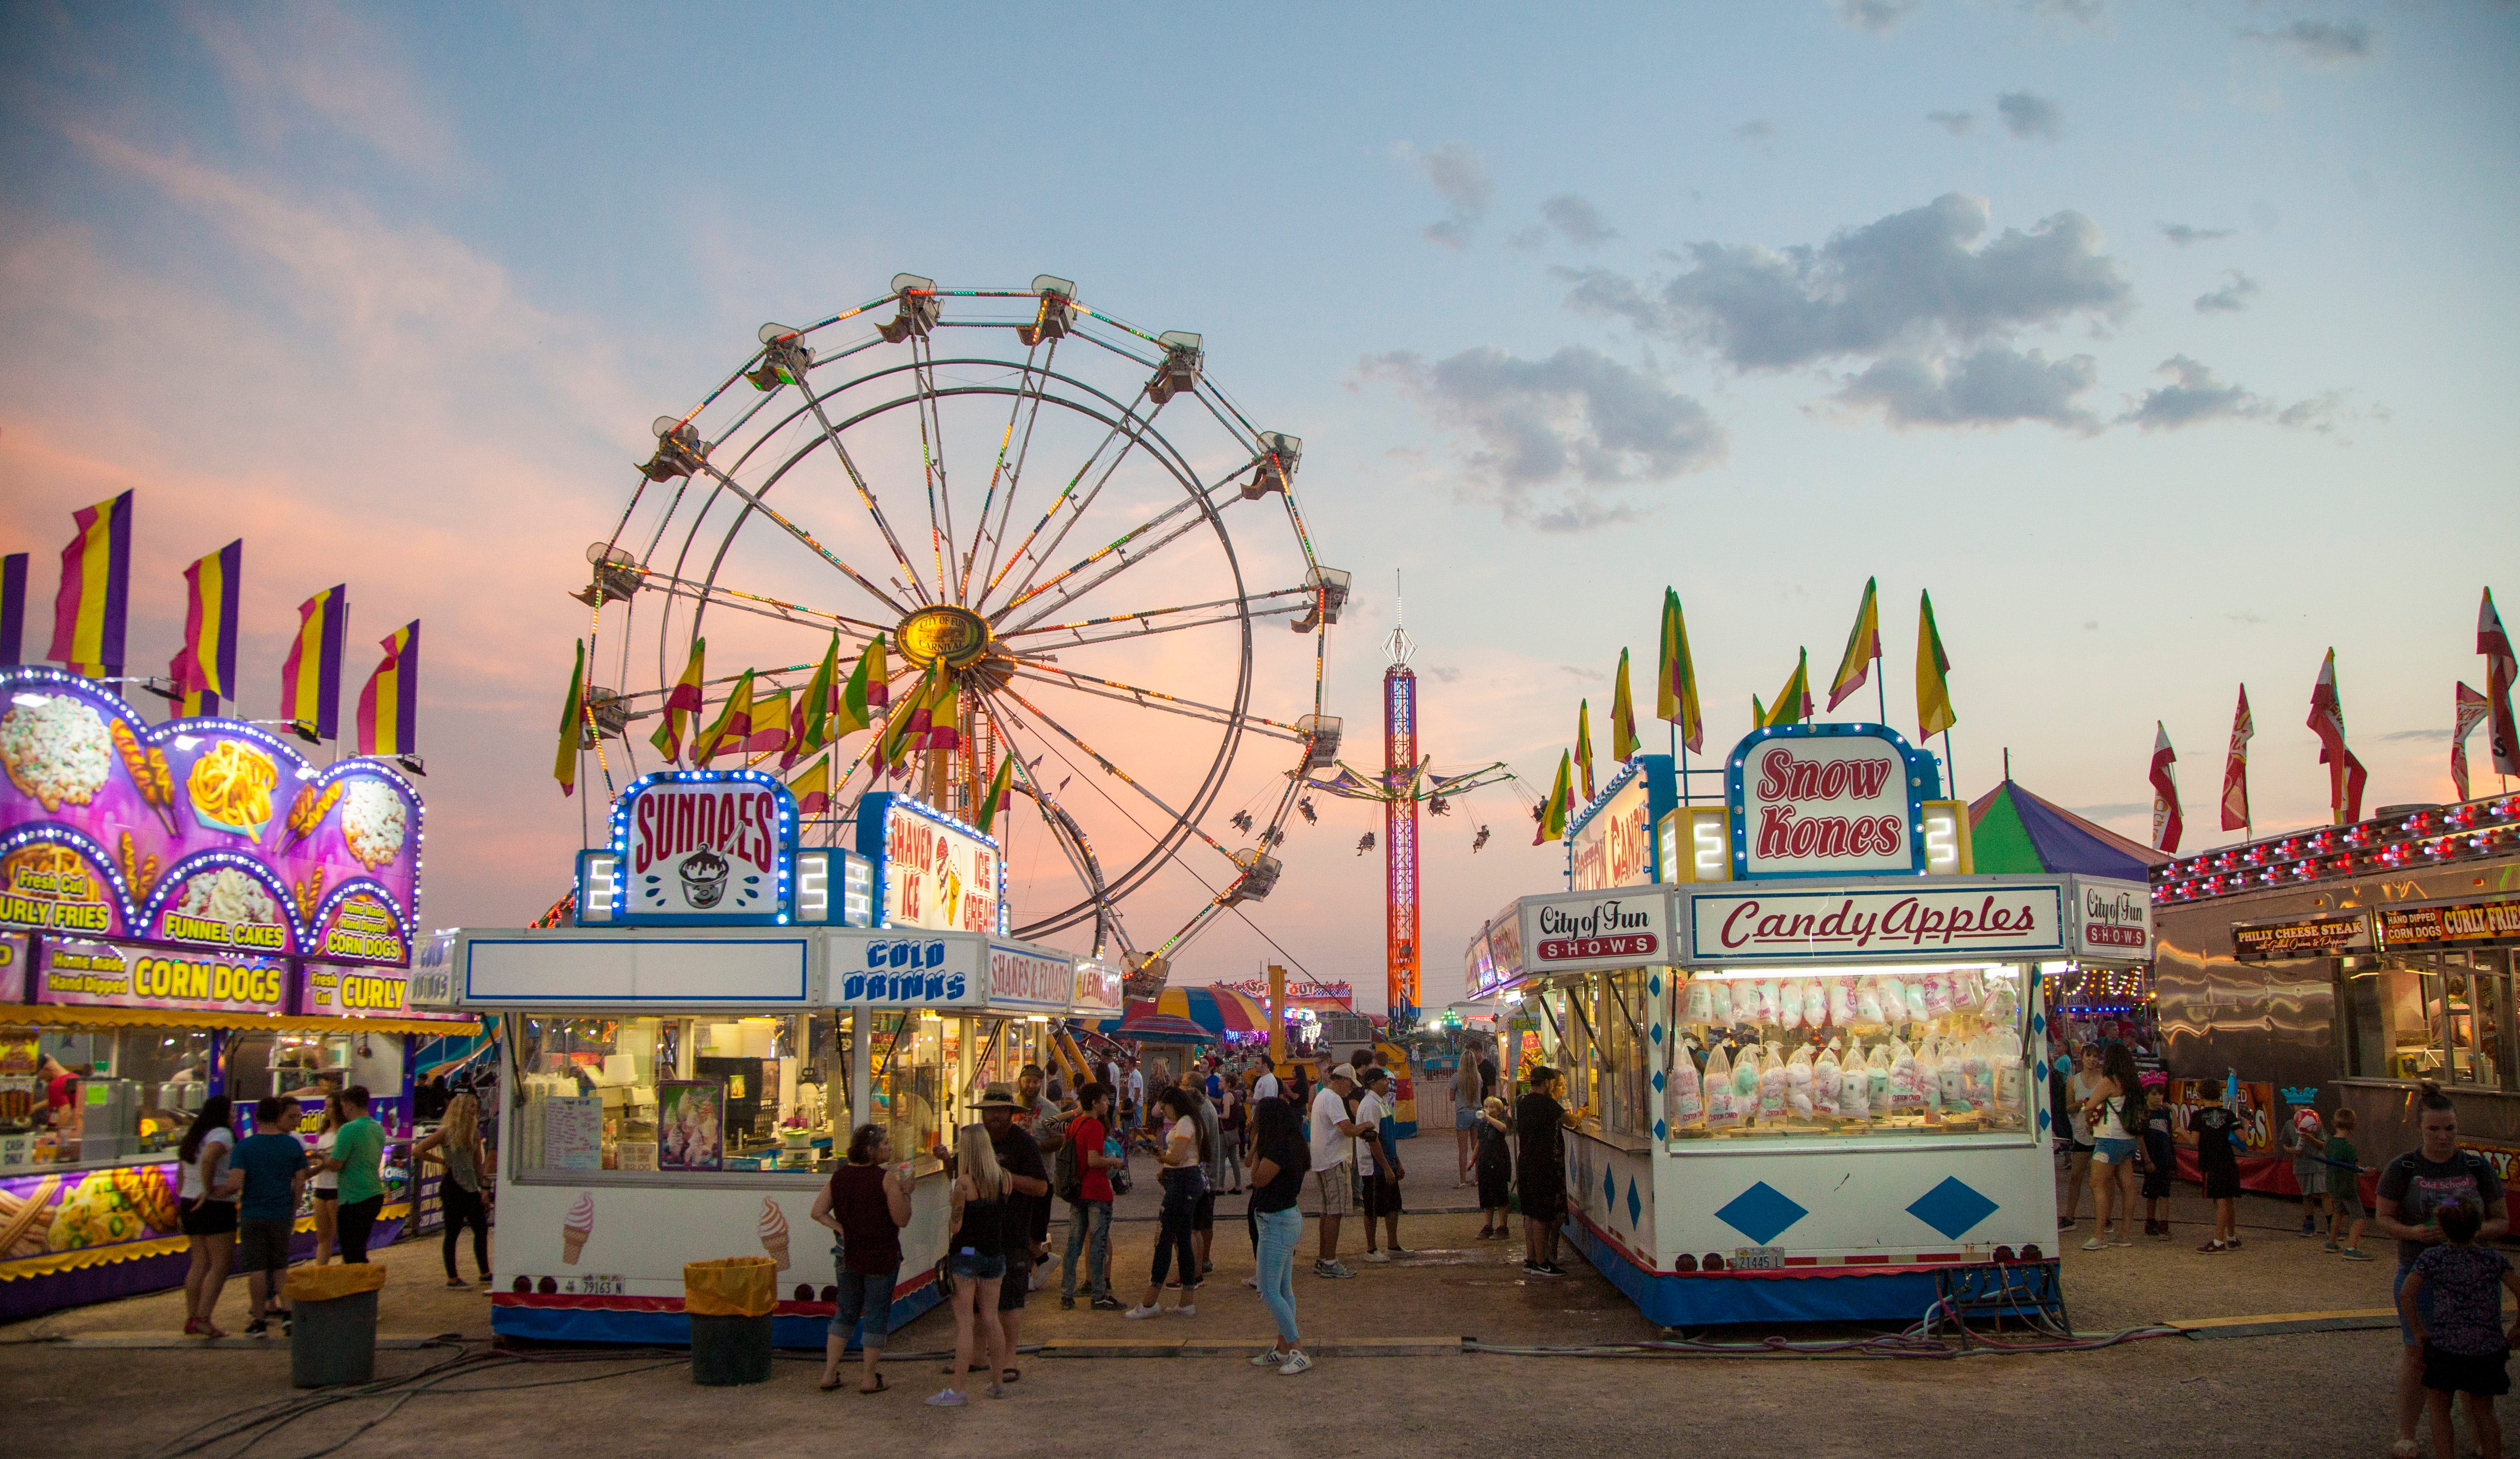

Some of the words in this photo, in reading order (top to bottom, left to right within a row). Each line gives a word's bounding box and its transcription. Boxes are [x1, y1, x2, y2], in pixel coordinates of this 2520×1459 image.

[920, 617, 939, 629] CITY
[939, 616, 949, 624] OF
[951, 617, 966, 628] FUN
[919, 640, 963, 651] CARNIVAL
[1757, 748, 1892, 802] Snow
[636, 792, 773, 874] SUNDAES
[890, 811, 933, 876] SHAVED
[1756, 805, 1902, 859] Kones
[1574, 830, 1607, 891] COTTON
[1611, 800, 1646, 887] CANDY
[19, 869, 56, 891] Fresh
[61, 875, 83, 894] Cut
[975, 846, 990, 893] ICE
[901, 869, 920, 923] ICE
[2087, 889, 2108, 927] City
[2110, 895, 2121, 927] of
[2121, 892, 2142, 922] Fun
[0, 895, 50, 923] URLY
[55, 904, 107, 930] FRIES
[344, 902, 364, 915] Home
[366, 904, 385, 917] Made
[964, 890, 996, 936] CREAM
[1540, 906, 1579, 940] City
[1582, 905, 1602, 939] of
[1603, 901, 1650, 930] Fun
[1721, 900, 1877, 948] Candy
[1880, 896, 2035, 945] Apples
[2387, 915, 2408, 925] HAND
[2409, 912, 2436, 923] DIPPED
[2444, 908, 2485, 934] CURLY
[2486, 905, 2520, 931] FRIE
[165, 915, 230, 943] FUNNEL
[233, 924, 283, 948] CAKES
[342, 919, 360, 930] Hand
[361, 920, 386, 934] Dipped
[2238, 929, 2273, 942] PHILLY
[2275, 926, 2319, 939] CHEESE
[2321, 921, 2363, 934] STEAK
[2388, 928, 2413, 940] CORN
[2415, 925, 2442, 937] DOGS
[328, 931, 362, 956] CORN
[366, 937, 398, 959] DOGS
[867, 939, 945, 968] COLD
[2256, 941, 2267, 950] with
[53, 951, 90, 969] Home
[48, 973, 83, 991] Hand
[84, 977, 128, 995] Dipped
[135, 958, 209, 998] CORN
[213, 966, 281, 1002] DOGS
[312, 973, 338, 987] Fresh
[842, 969, 965, 1001] DRINKS
[991, 953, 1030, 998] SHAKES
[1030, 971, 1037, 998] &
[1038, 966, 1068, 1003] FLOATS
[1081, 973, 1120, 1008] LEMONADE
[1246, 981, 1270, 995] SPI
[1289, 982, 1316, 995] OUT
[316, 991, 331, 1005] Cut
[342, 975, 407, 1009] CURLY
[1683, 1113, 1697, 1122] COTTON
[1709, 1113, 1724, 1122] COTTON
[1818, 1105, 1833, 1113] CANDY
[295, 1113, 318, 1133] old
[2440, 1177, 2469, 1188] School
[1739, 1256, 1769, 1268] 21445
[1775, 1255, 1780, 1267] L
[584, 1282, 610, 1294] 79163
